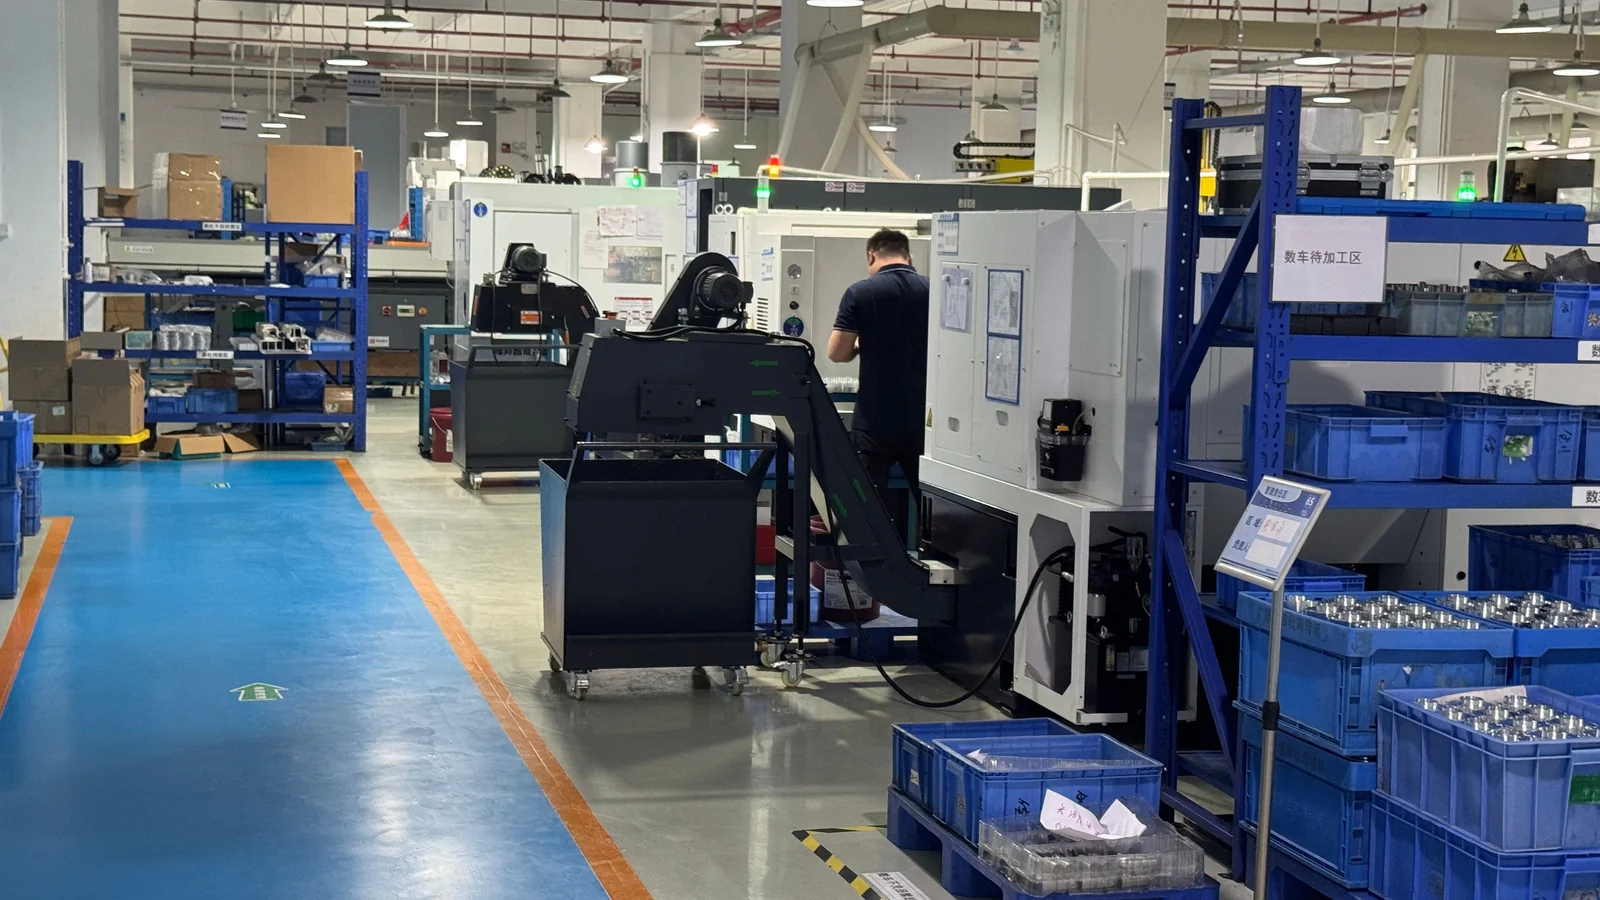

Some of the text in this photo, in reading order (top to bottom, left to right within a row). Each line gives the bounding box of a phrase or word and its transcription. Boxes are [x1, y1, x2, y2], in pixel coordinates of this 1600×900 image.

[1284, 250, 1362, 264] 数车待加工区
[1305, 496, 1315, 507] 6S
[1585, 490, 1600, 504] 数
